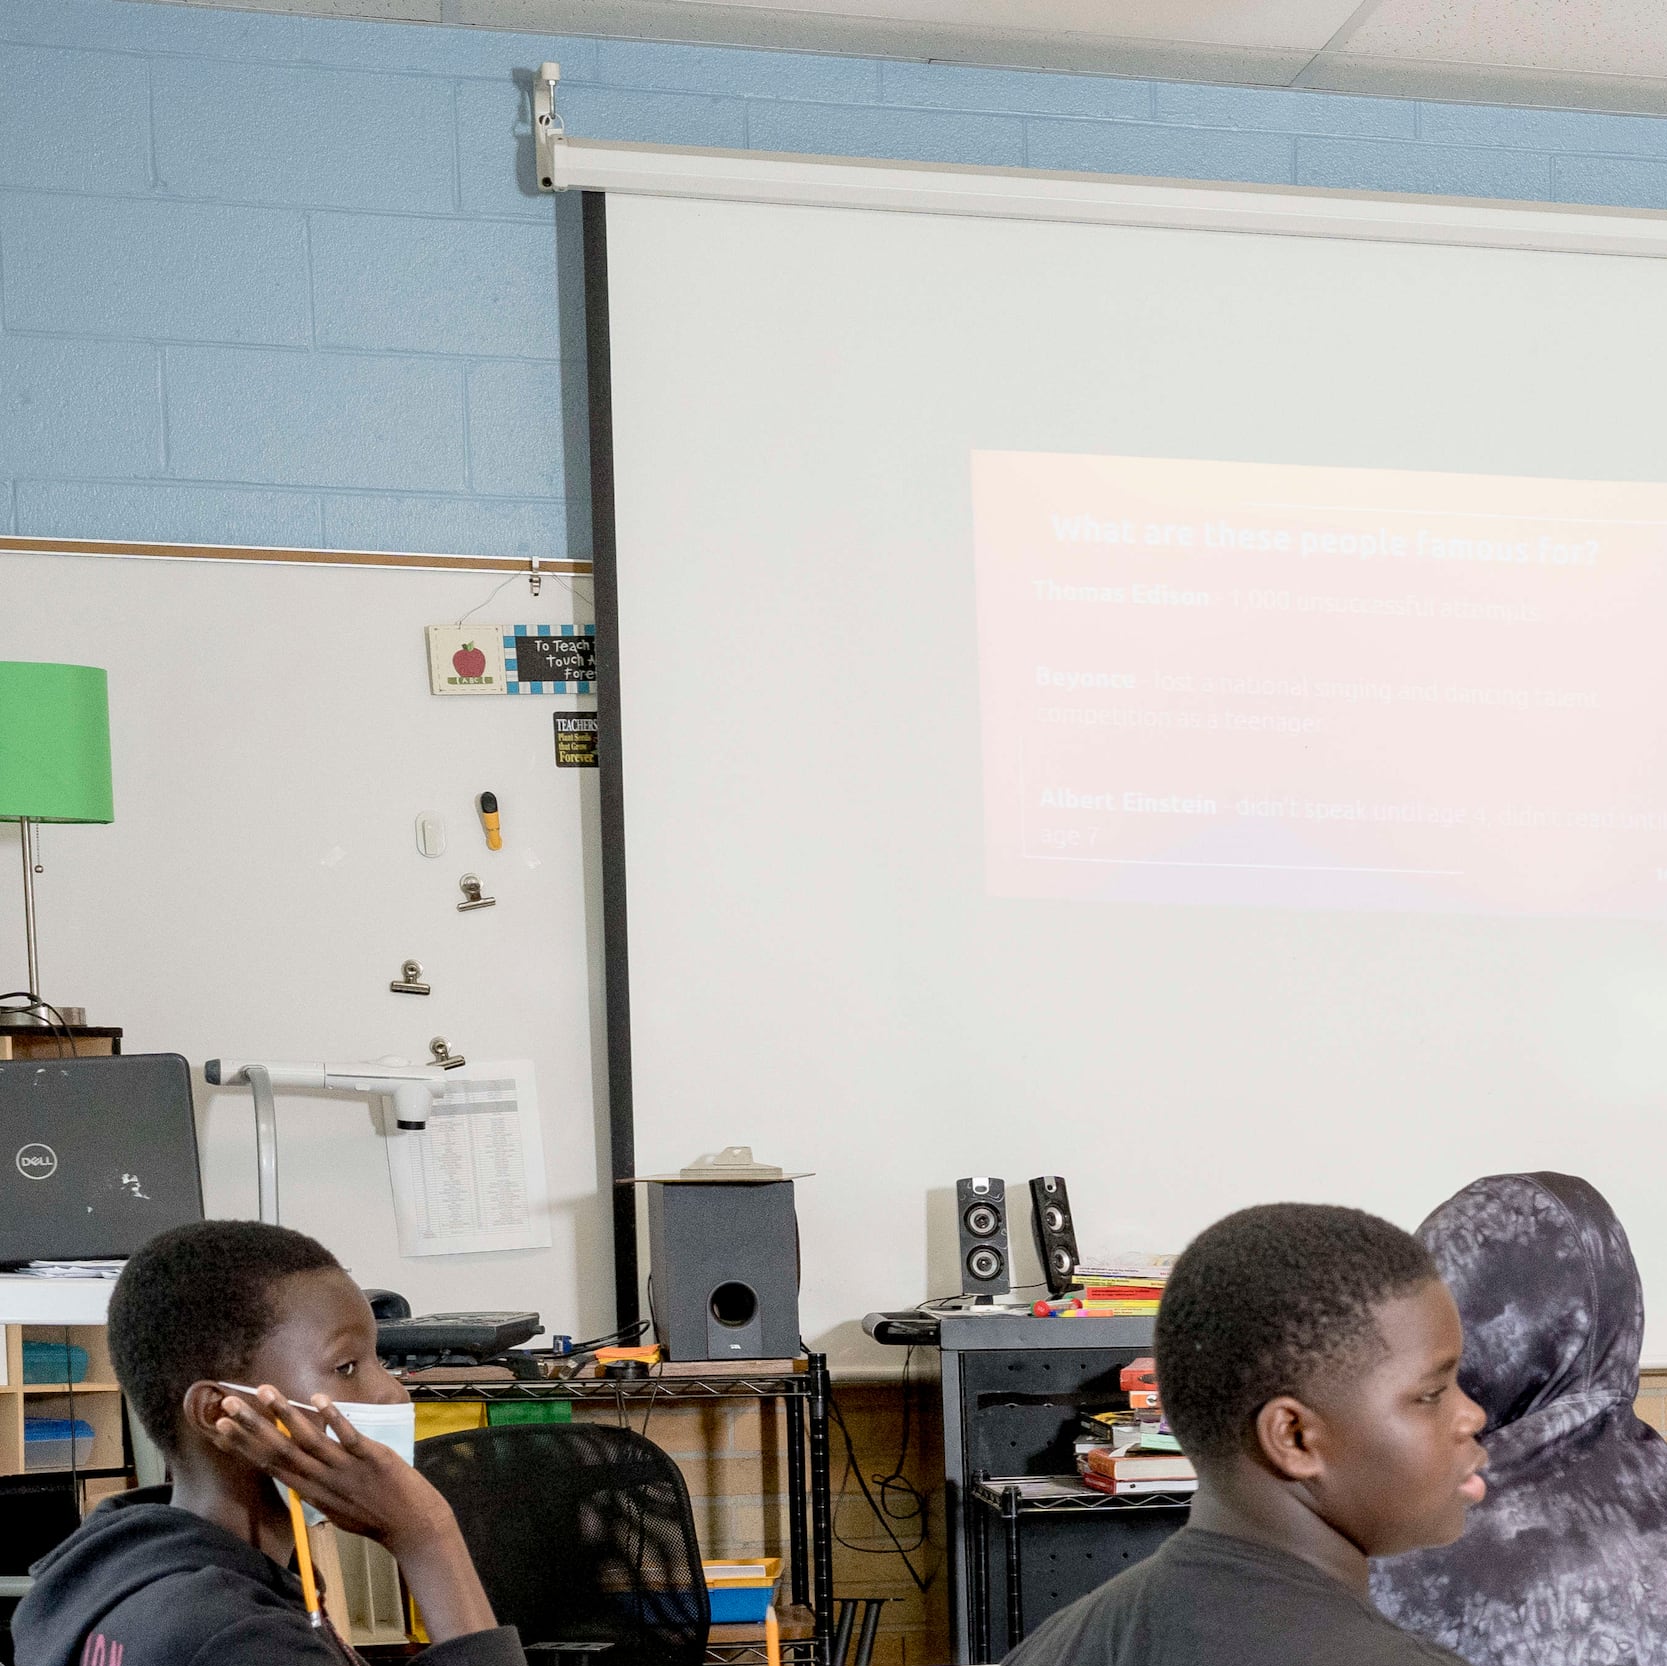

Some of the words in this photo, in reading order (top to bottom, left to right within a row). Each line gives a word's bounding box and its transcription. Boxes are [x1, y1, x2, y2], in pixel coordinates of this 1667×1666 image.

[1050, 512, 1136, 544] What
[1143, 524, 1195, 547] are
[1204, 520, 1291, 552] these
[1301, 527, 1408, 561] people
[1416, 529, 1529, 563] famous
[1538, 534, 1601, 567] for?
[1032, 579, 1126, 604] Thomas
[1131, 583, 1210, 607] Edison
[1231, 588, 1290, 614] 1,000
[1297, 594, 1434, 618] unsuccessful
[534, 640, 550, 652] To
[552, 639, 590, 652] Teach
[1035, 665, 1136, 691] Beyonce
[1154, 670, 1195, 690] lost
[1202, 677, 1213, 690] a
[1220, 674, 1308, 697] national
[1314, 678, 1391, 703] singing
[1398, 681, 1438, 702] and
[1445, 682, 1528, 709] dancing
[1535, 688, 1600, 709] talent
[556, 719, 598, 731] TEACHERS
[1037, 706, 1171, 730] competition
[1178, 711, 1200, 729] as
[559, 751, 594, 763] Forever
[1040, 787, 1114, 811] Albert
[1122, 791, 1216, 815] Einstein
[1235, 795, 1297, 818] didn't
[1304, 799, 1363, 823] speak
[1373, 801, 1423, 823] until
[1427, 806, 1467, 828] age
[1498, 805, 1562, 828] didn't
[1567, 809, 1614, 829] read
[1040, 827, 1080, 849] age
